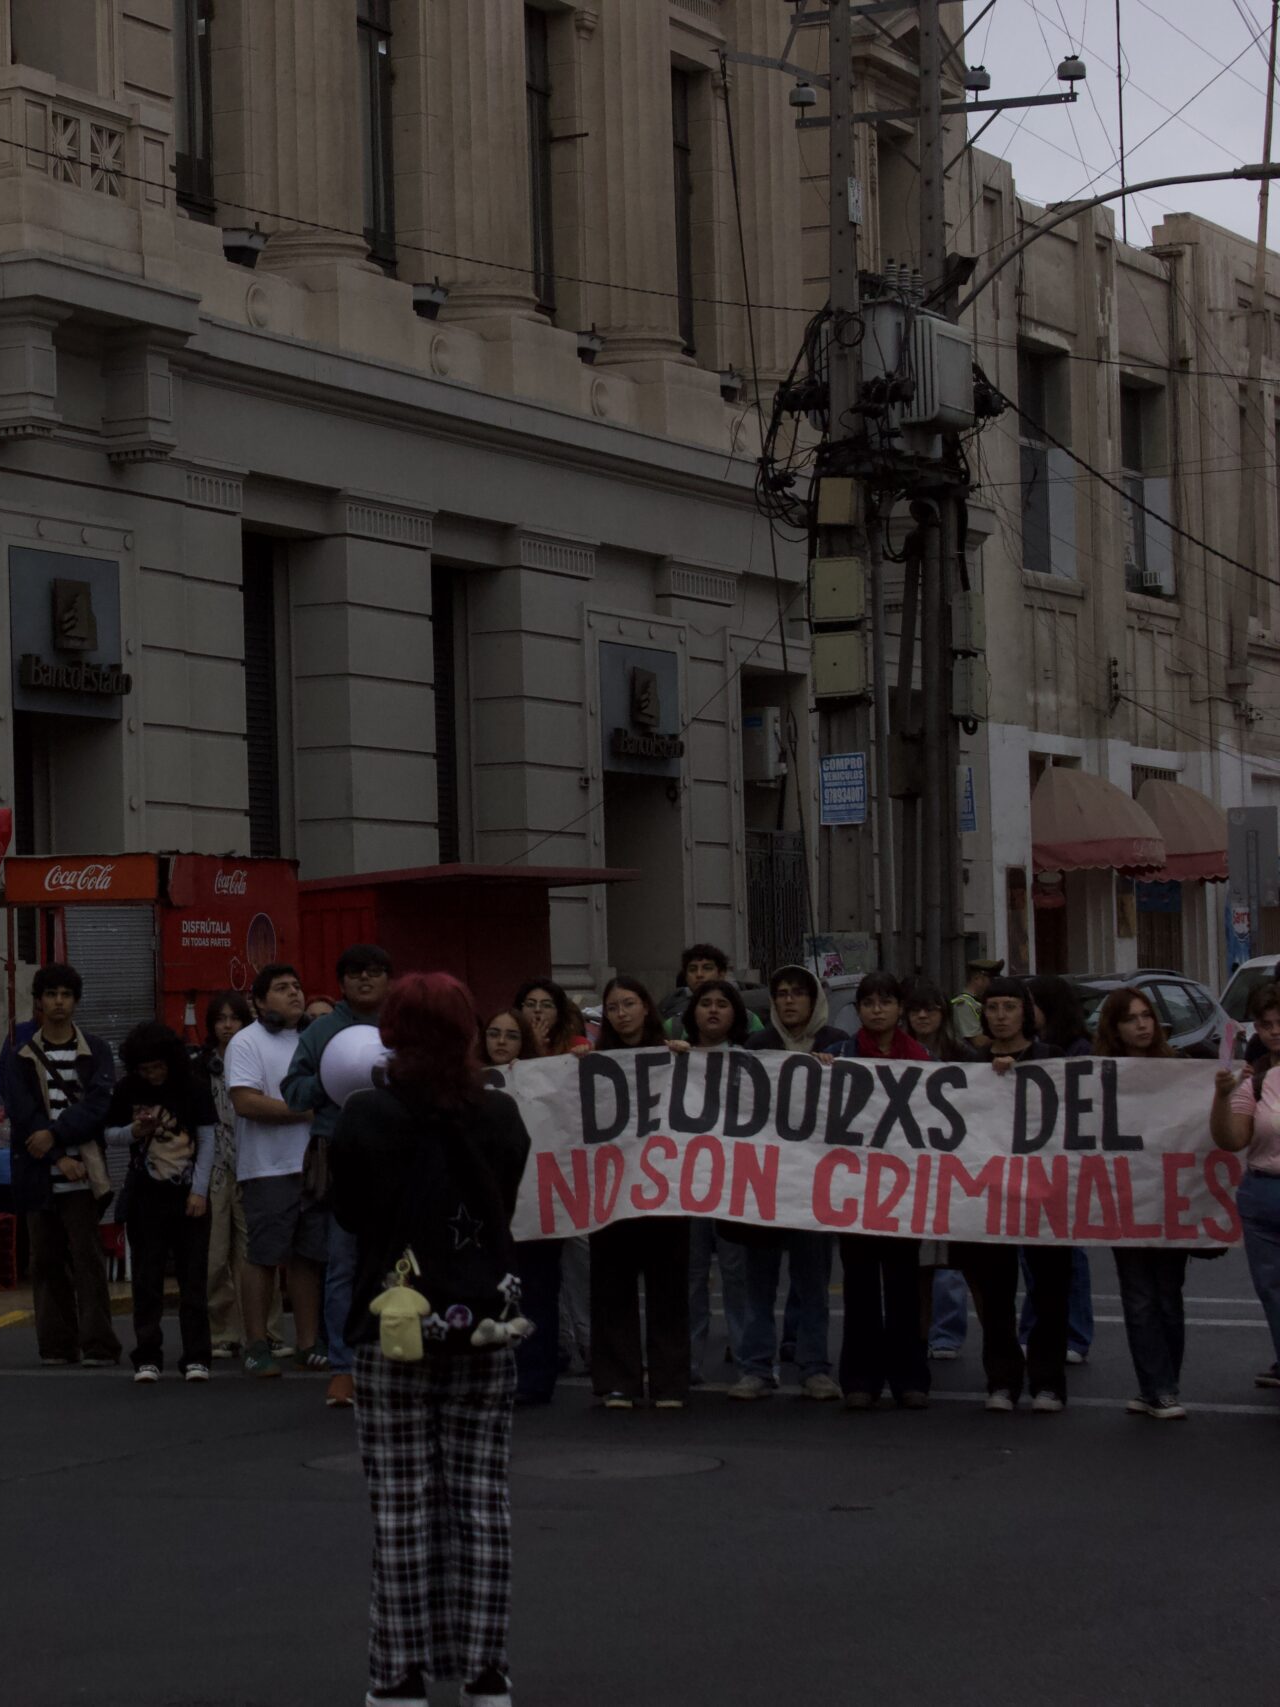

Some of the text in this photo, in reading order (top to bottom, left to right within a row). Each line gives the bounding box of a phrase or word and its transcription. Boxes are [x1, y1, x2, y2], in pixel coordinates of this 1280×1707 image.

[21, 654, 132, 695] BancoEstado
[822, 756, 863, 771] COMPRO
[43, 863, 117, 892] Coca-Cola
[214, 868, 248, 896] Coca-Cola
[181, 917, 232, 934] DISFRÚTALA
[181, 937, 232, 947] EN TODAS PARTES
[578, 1051, 1144, 1154] DEUDORXS DEL
[536, 1135, 1243, 1243] NO SON CRIMINALES
